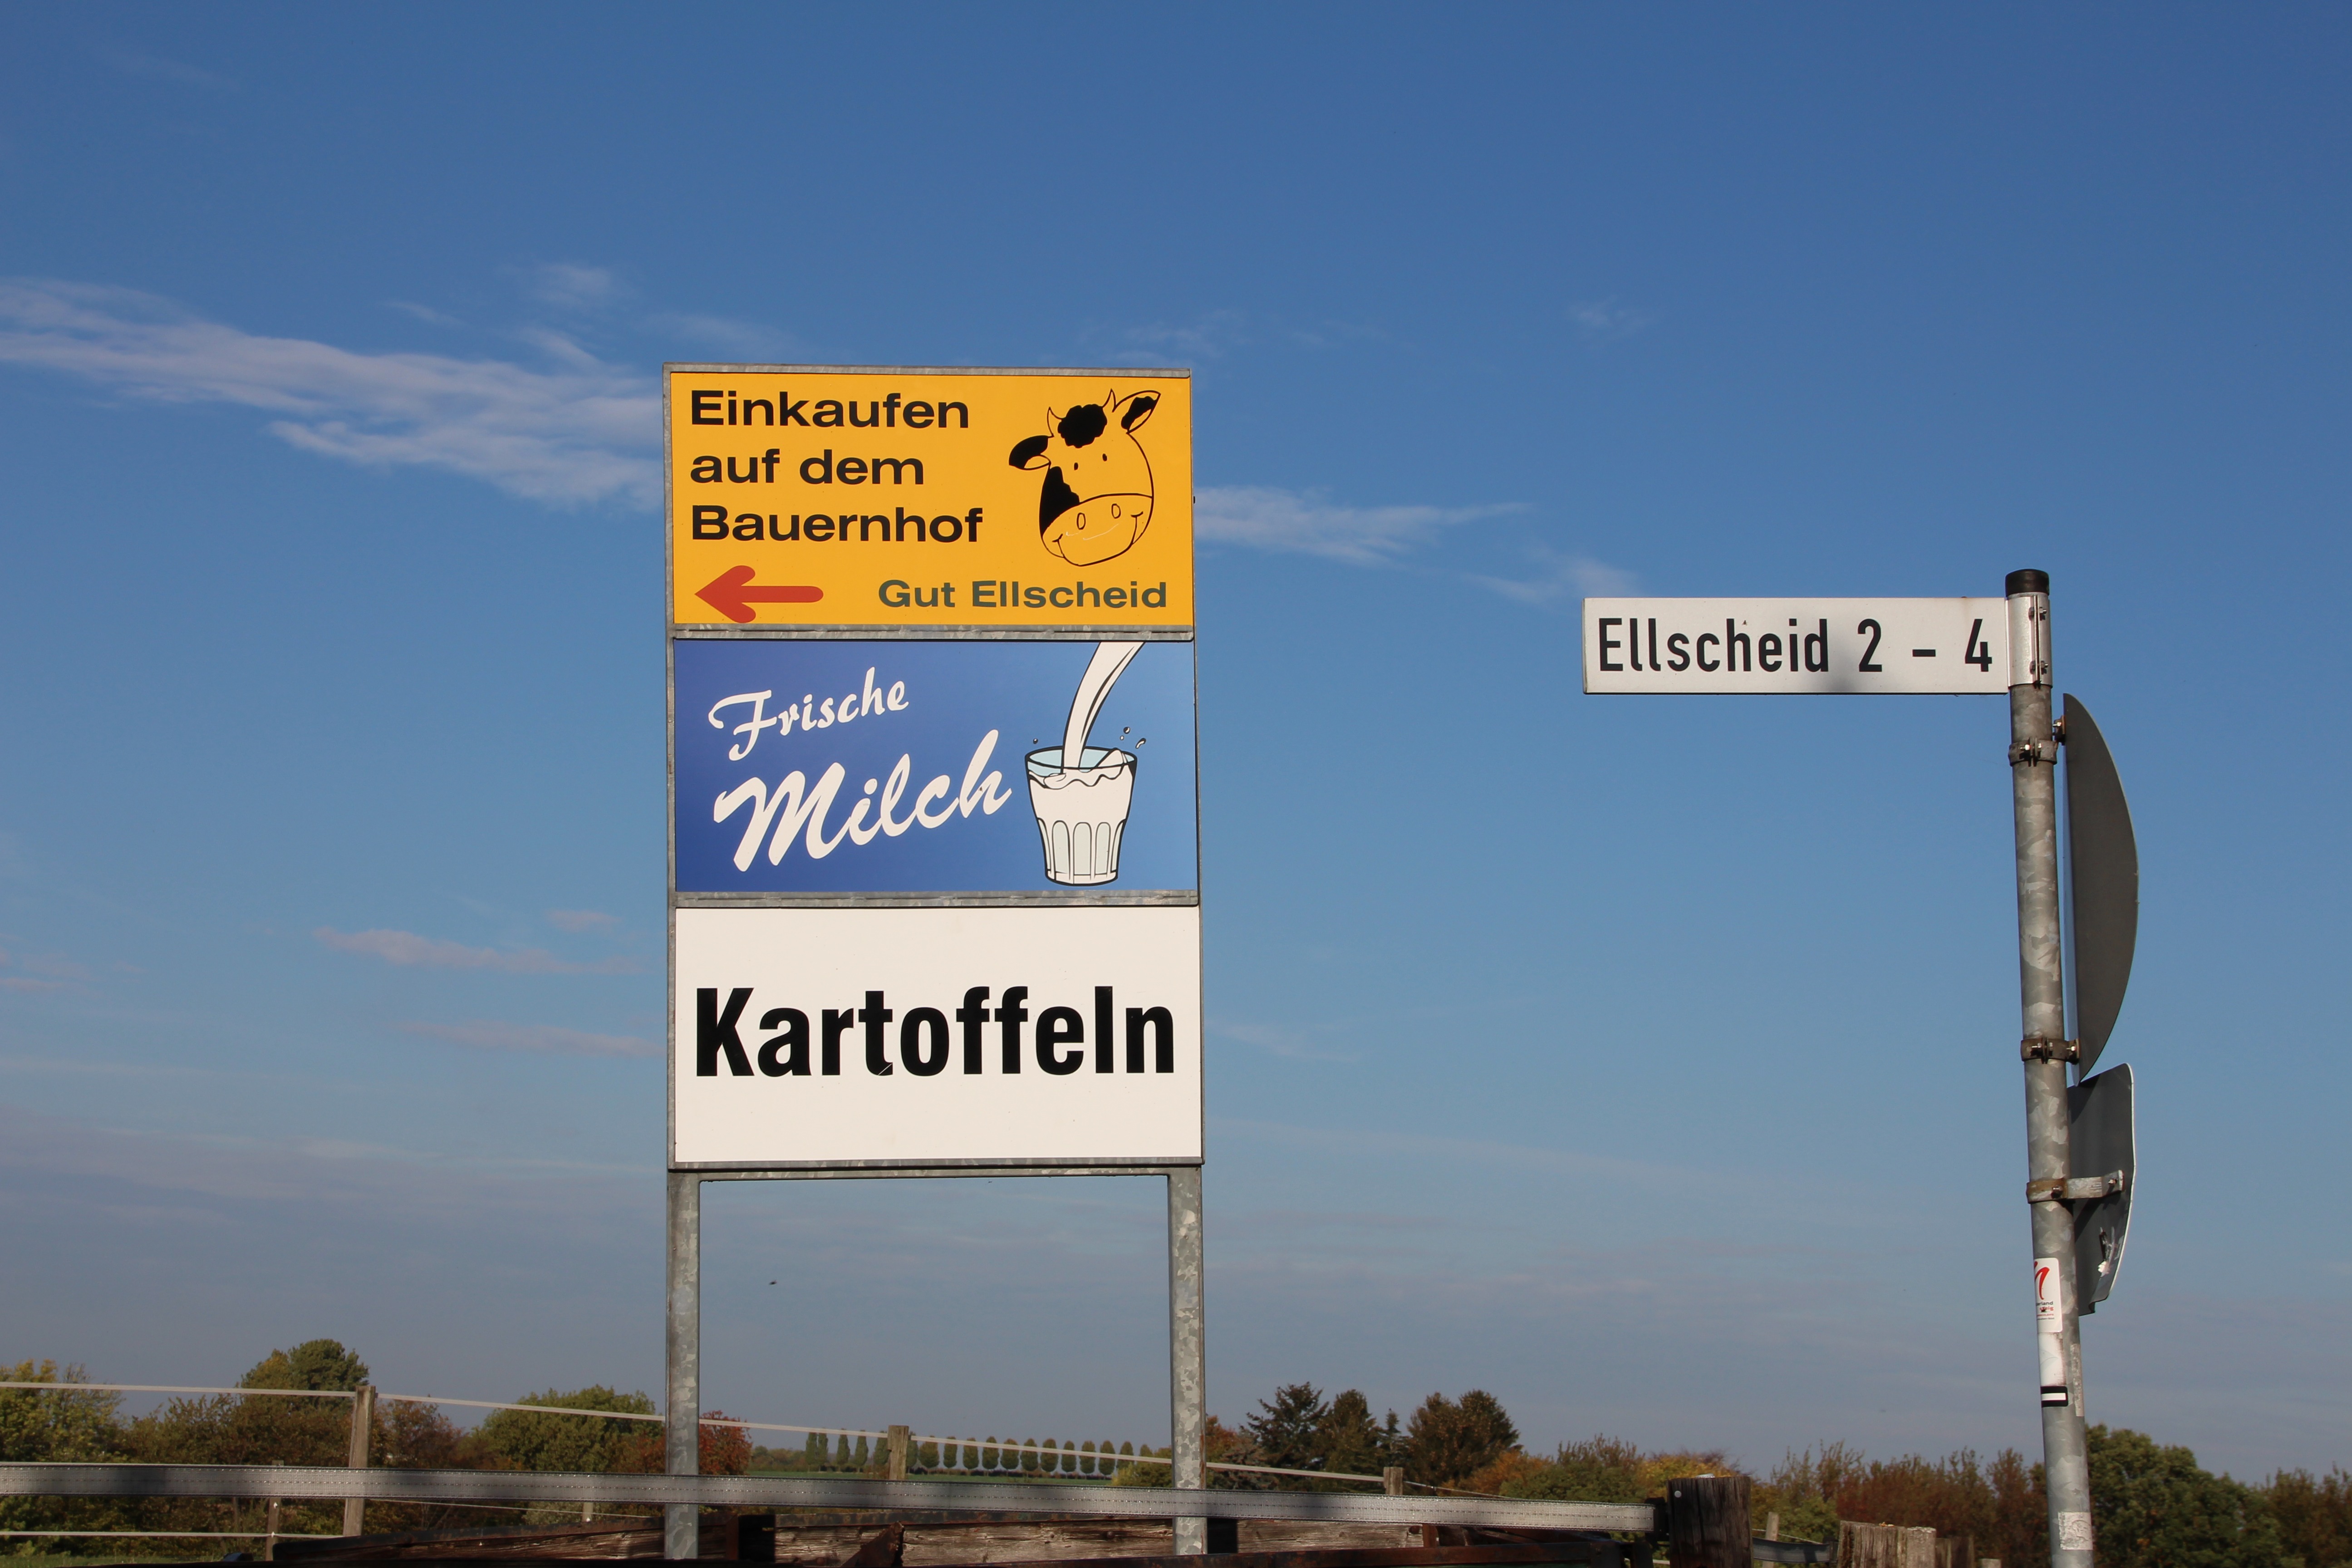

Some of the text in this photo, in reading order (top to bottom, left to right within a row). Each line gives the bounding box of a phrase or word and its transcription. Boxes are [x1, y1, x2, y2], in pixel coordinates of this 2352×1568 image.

[692, 390, 968, 428] Einkaufen
[691, 449, 923, 485] auf dem
[692, 505, 983, 543] Bauernhof
[879, 580, 1167, 608] Gut Ellscheid
[1599, 618, 1829, 672] Ellscheid
[1857, 619, 1882, 672] 2
[1965, 619, 1992, 672] 4
[708, 667, 909, 761] Frische
[713, 729, 1012, 872] Milch
[696, 986, 1174, 1077] Kartoffeln
